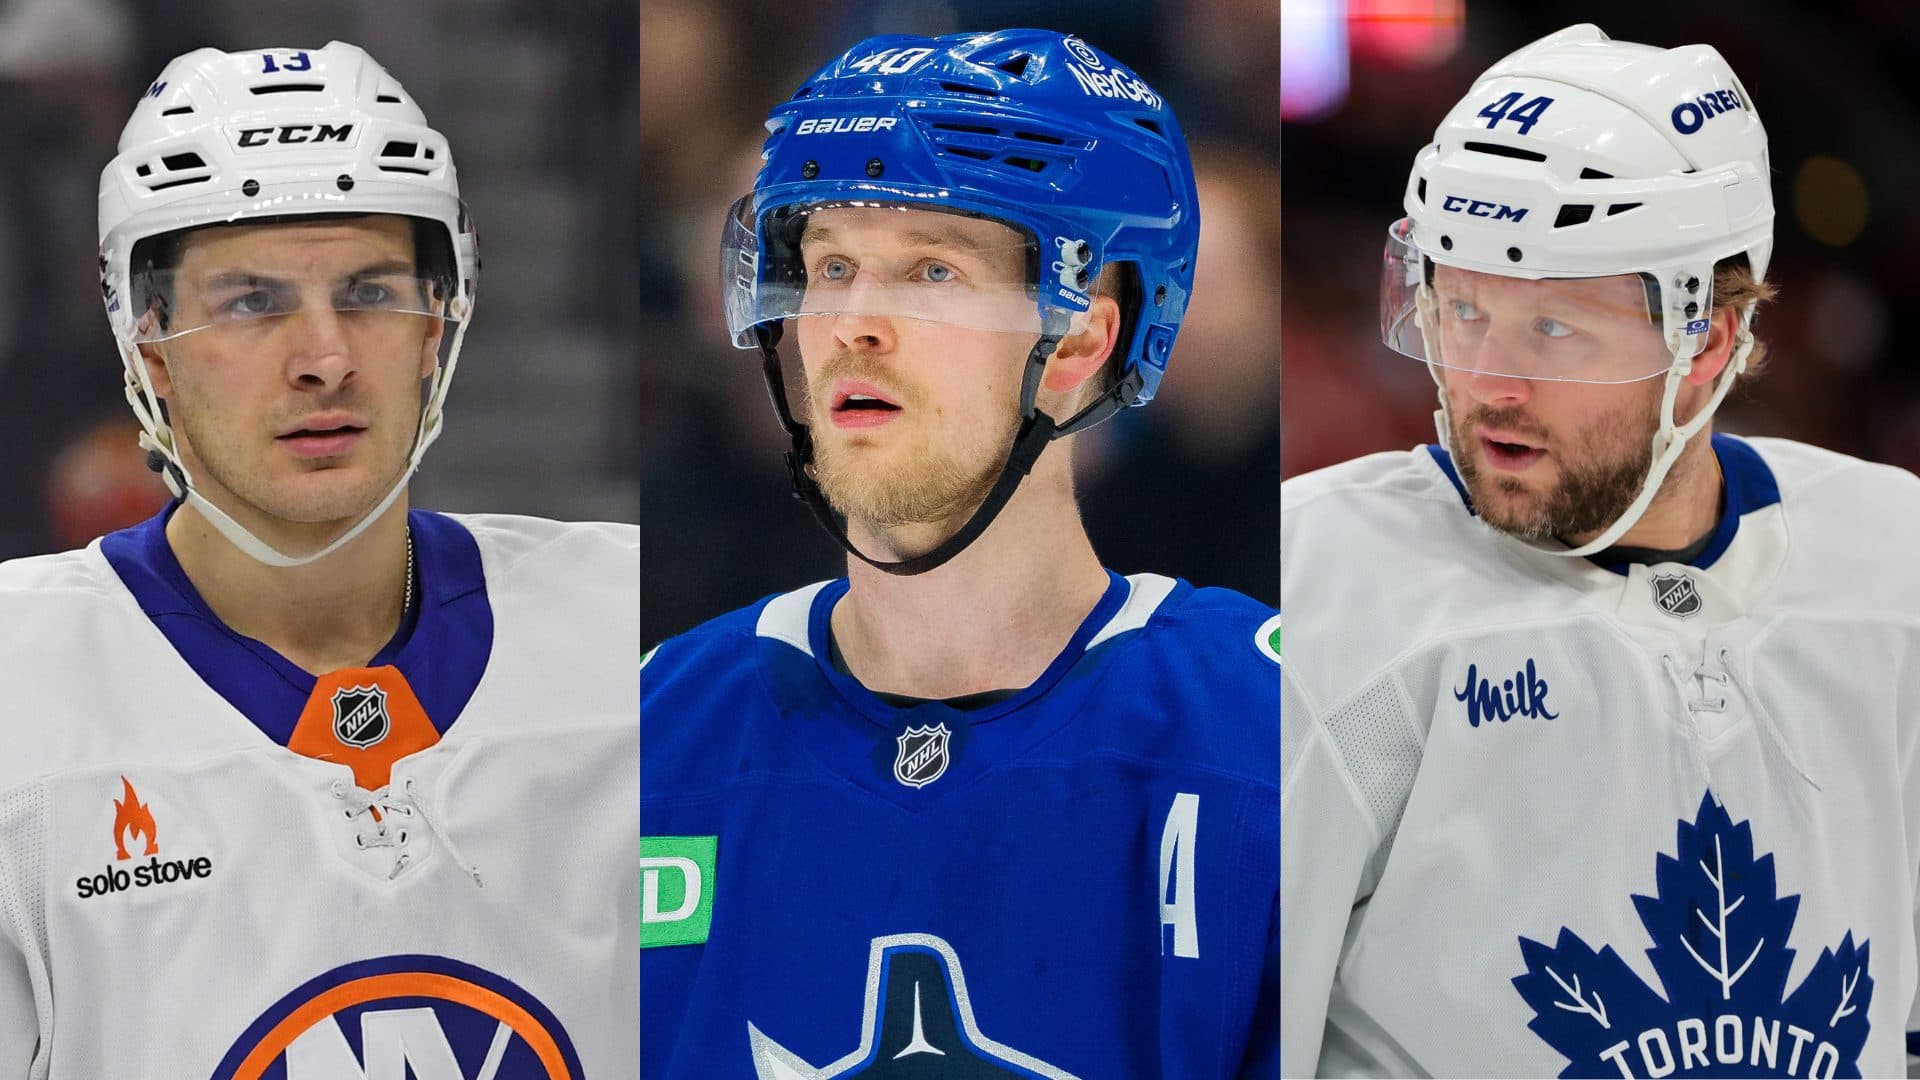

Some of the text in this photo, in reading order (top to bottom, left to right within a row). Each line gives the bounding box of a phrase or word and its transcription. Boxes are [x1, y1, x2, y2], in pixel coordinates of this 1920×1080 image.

[262, 52, 311, 74] 13
[850, 48, 935, 74] 40
[1477, 91, 1555, 135] 44
[1671, 89, 1741, 135] OREO
[238, 124, 353, 148] CCM
[1443, 195, 1529, 223] CCM
[1664, 583, 1690, 609] NHL
[1454, 658, 1559, 728] Milk
[346, 701, 377, 736] NHL
[907, 740, 940, 776] NHL
[76, 856, 212, 898] solo stove
[640, 856, 702, 924] D
[1159, 792, 1201, 959] A
[1599, 1014, 1840, 1079] TORONTO
